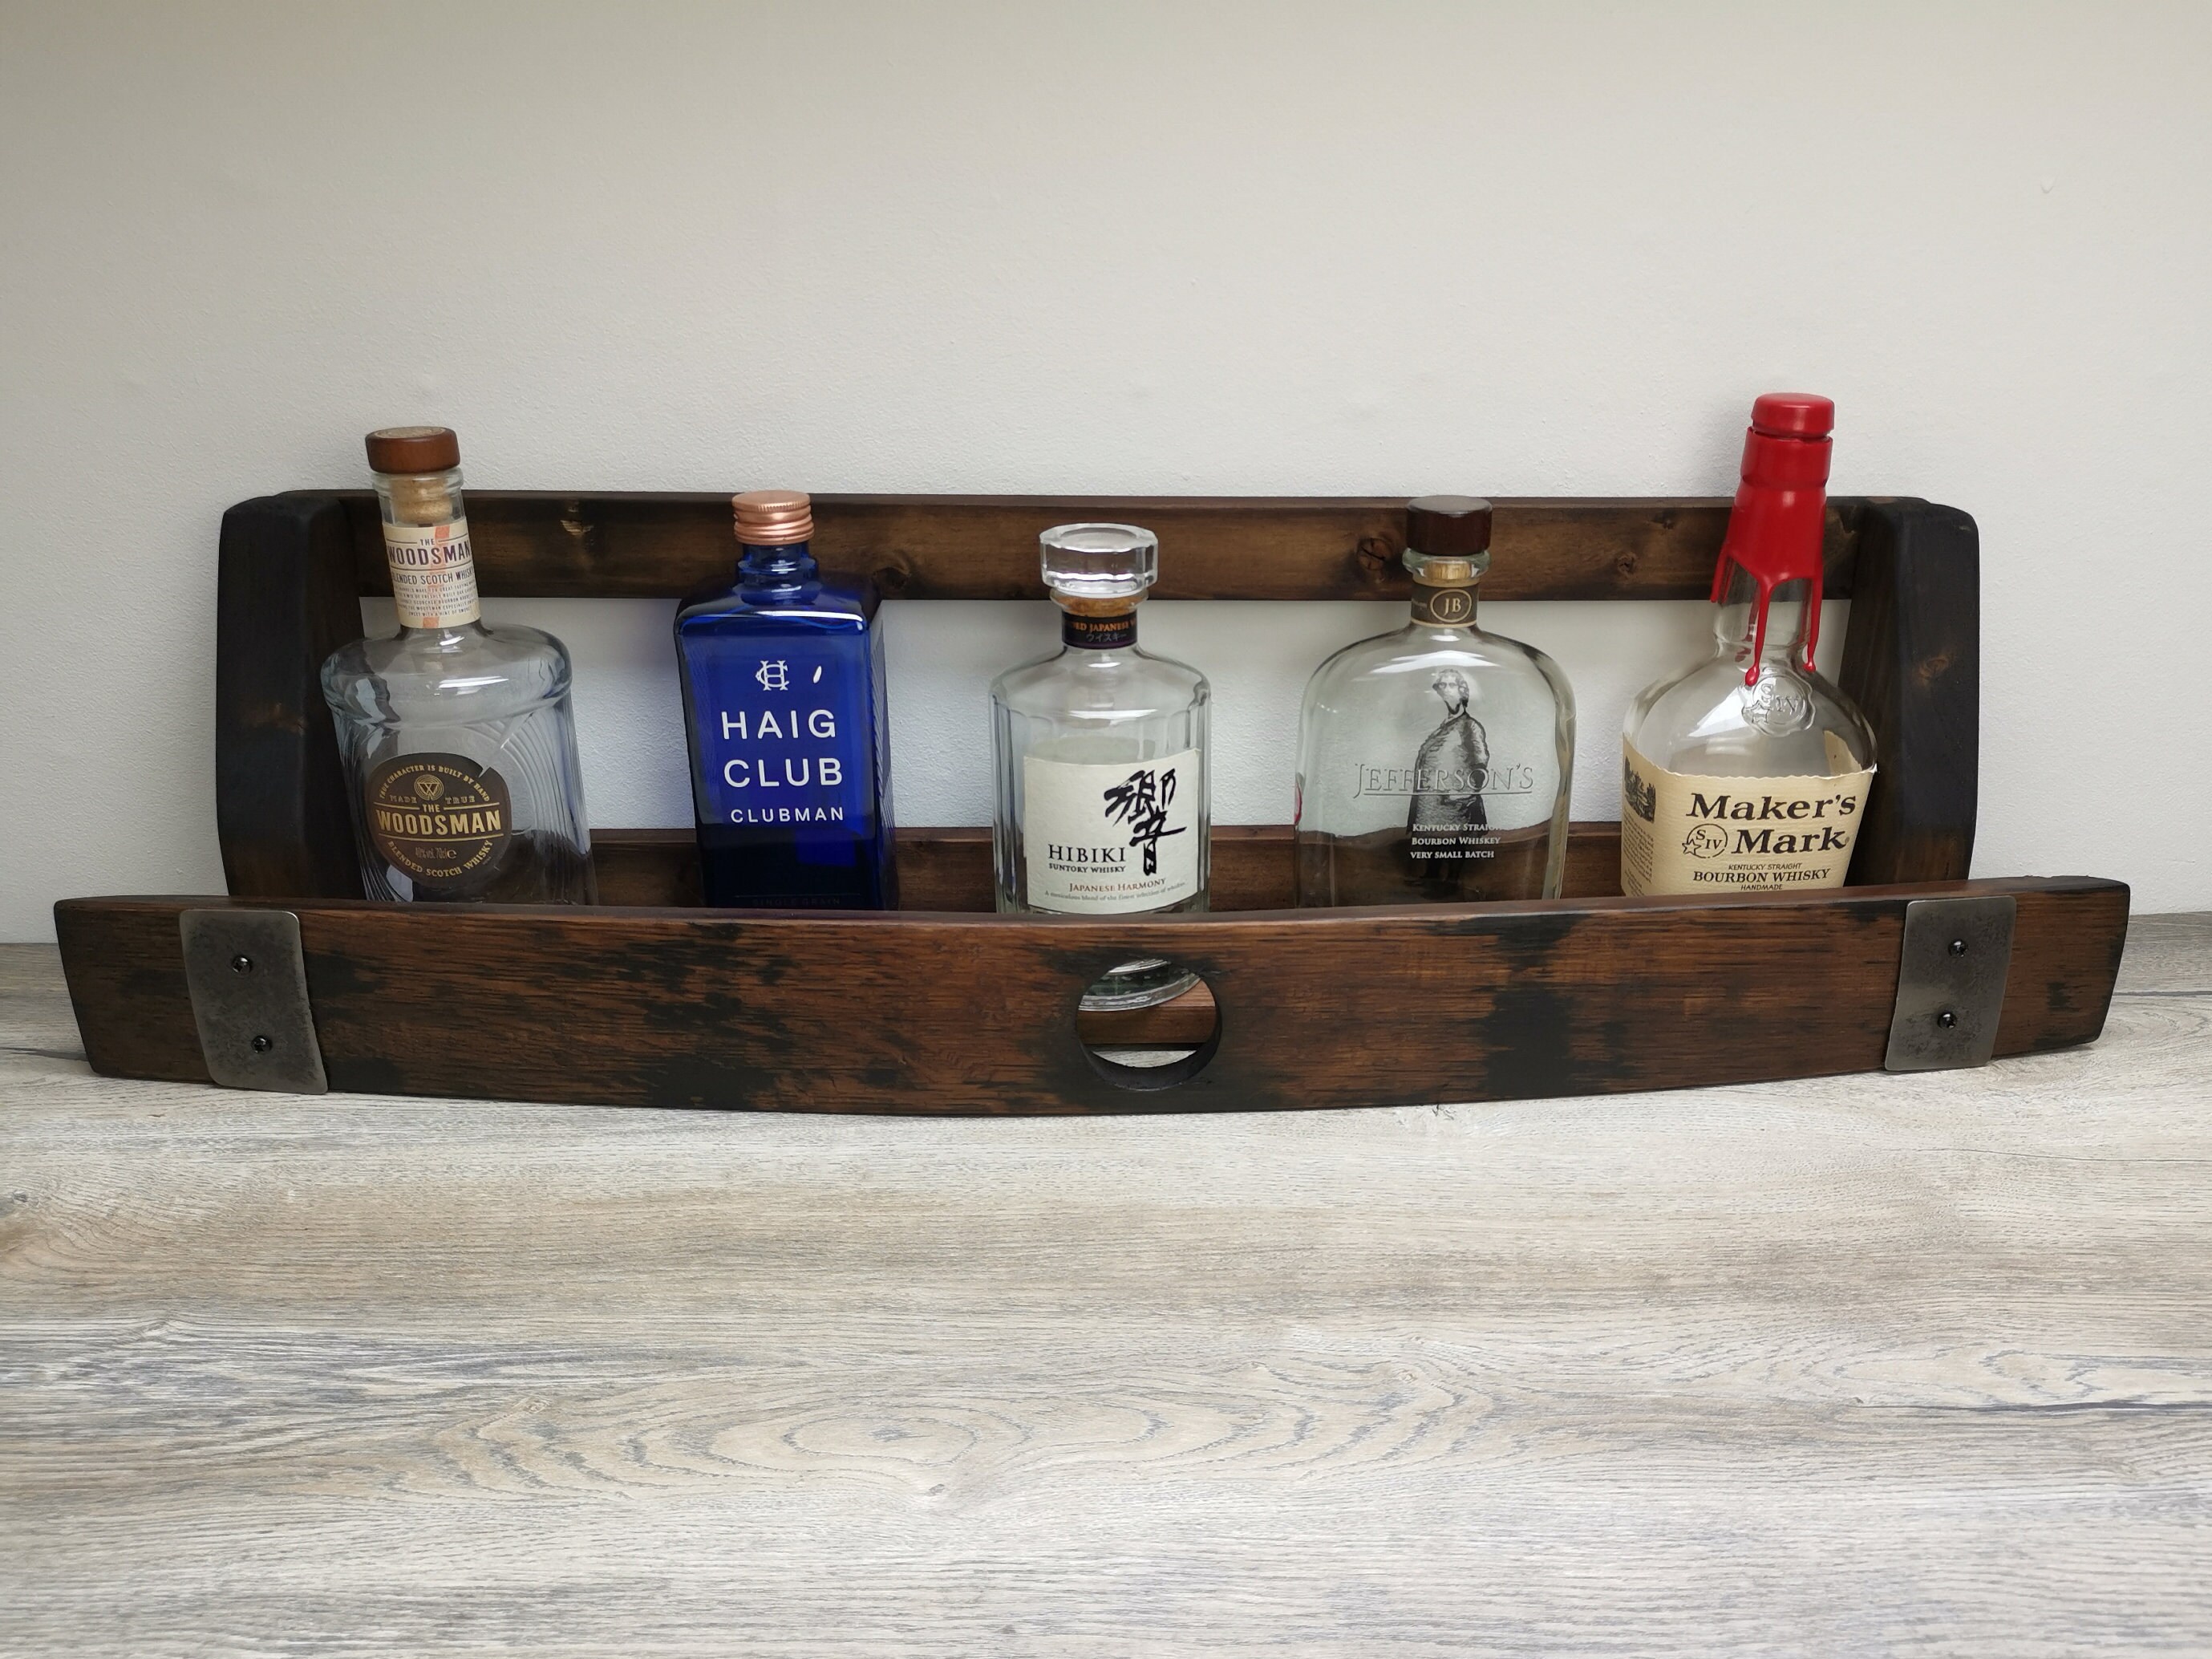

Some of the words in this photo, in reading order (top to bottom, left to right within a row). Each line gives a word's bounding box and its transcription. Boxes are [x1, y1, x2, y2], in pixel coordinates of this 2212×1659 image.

[388, 541, 471, 566] WOODSMAN
[420, 574, 453, 585] SCOTCH
[1443, 598, 1461, 617] JB
[721, 709, 836, 740] HAIG
[723, 757, 843, 788] CLUB
[1353, 763, 1533, 799] JEFFERSON'S
[387, 765, 424, 784] CHARACTER
[439, 766, 462, 778] BUILT
[464, 775, 474, 784] BY
[473, 783, 490, 801] HAND
[423, 804, 440, 813] THE
[445, 795, 476, 805] TRUE
[1685, 793, 1857, 821] Maker's
[376, 809, 501, 835] WOODSMAN
[730, 806, 844, 823] CLUBMAN
[1412, 823, 1460, 832] KENTUCKY
[1412, 838, 1456, 846] BOURBON
[1459, 837, 1501, 845] WHISKEY
[1731, 826, 1847, 855] Mark
[388, 841, 423, 874] BLENDED
[426, 866, 463, 878] SCOTCH
[463, 839, 494, 870] WHISKY
[1048, 843, 1127, 863] HIBIKI
[1410, 851, 1433, 859] VERY
[1434, 851, 1463, 859] SMALL
[1465, 850, 1495, 858] BATCH
[1049, 862, 1088, 873] SUNTORY
[1091, 866, 1127, 874] WHISKY
[1767, 862, 1802, 870] STRAIGHT
[1693, 870, 1768, 883] BOURBON
[1772, 868, 1831, 882] WHISKY
[1070, 882, 1115, 892] JAPANESE
[1117, 878, 1167, 891] HARMONY
[1740, 883, 1784, 891] HANDMADE
